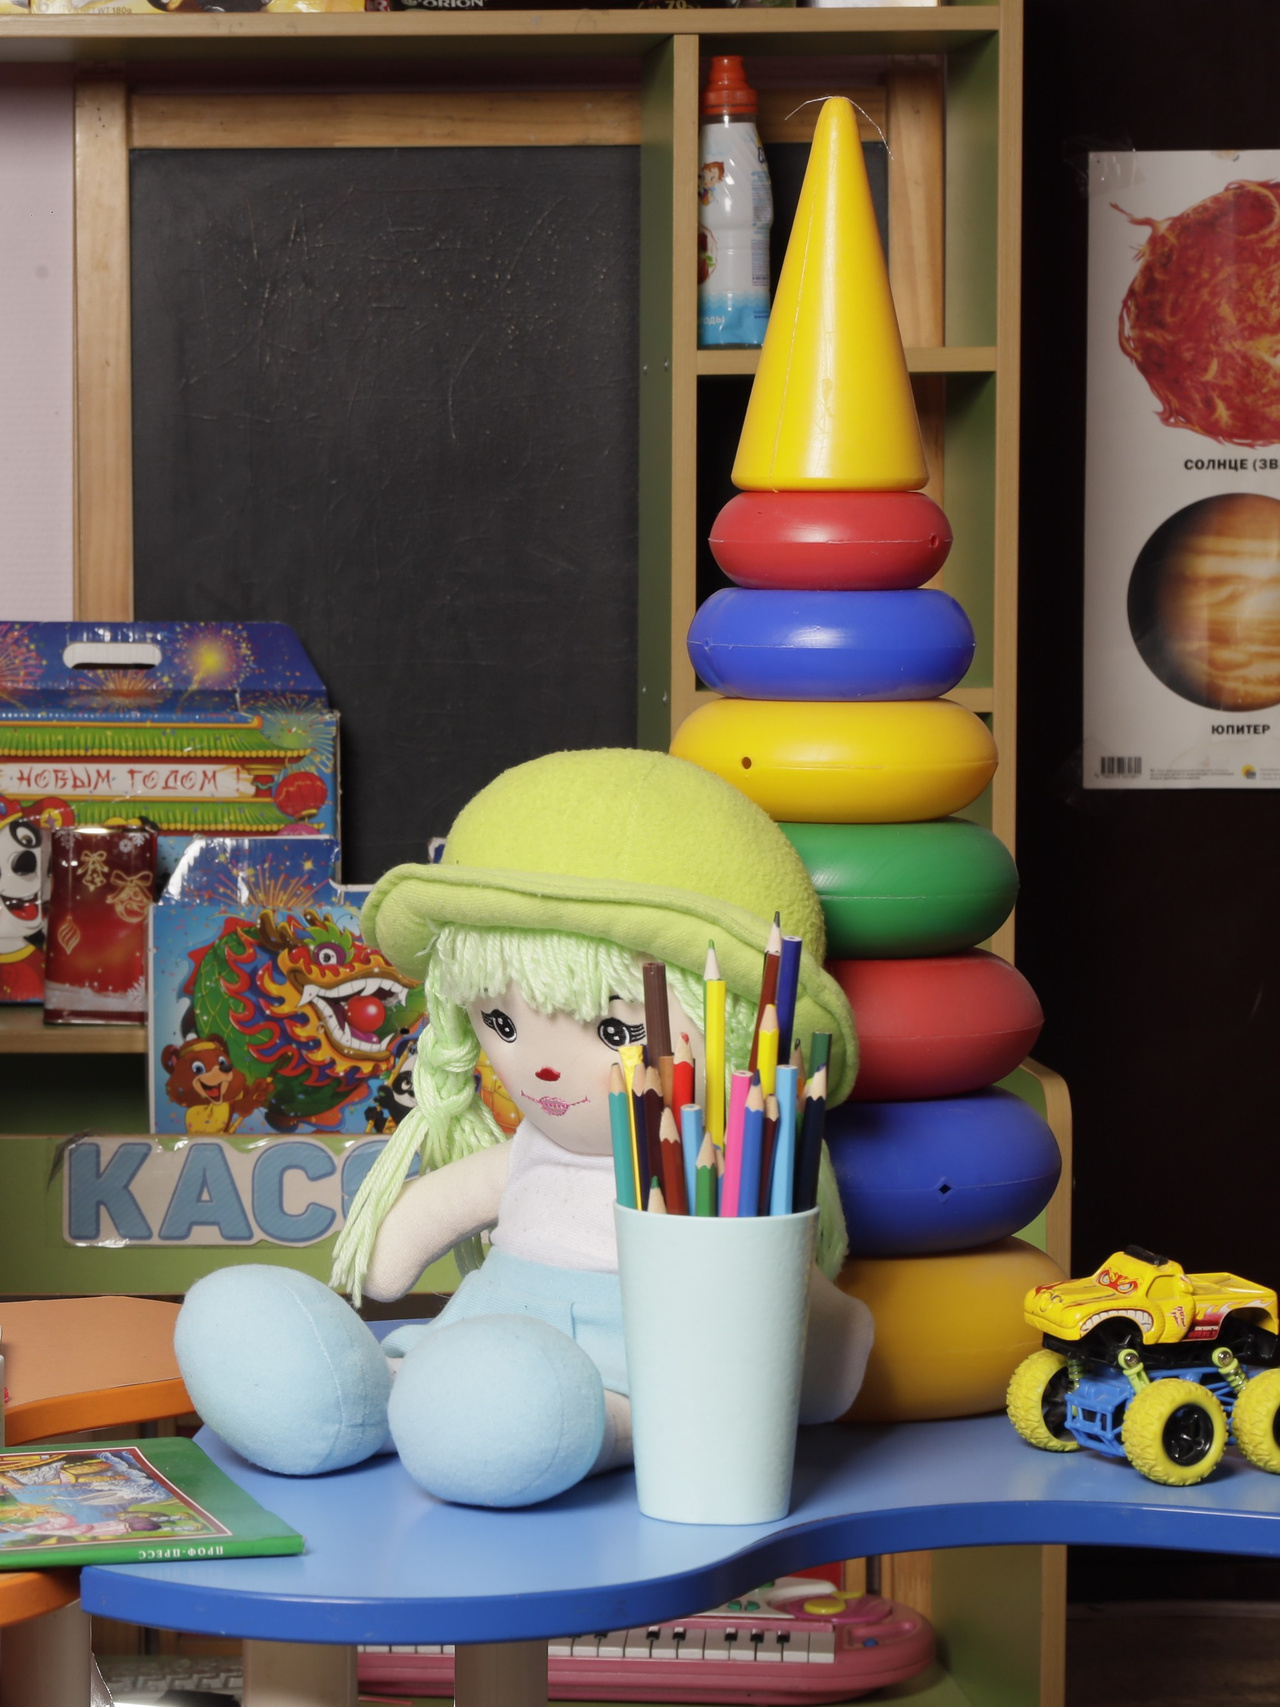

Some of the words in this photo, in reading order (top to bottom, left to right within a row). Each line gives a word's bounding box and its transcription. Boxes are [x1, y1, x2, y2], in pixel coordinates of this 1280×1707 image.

[1184, 459, 1248, 471] СОЛНЦЕ
[1253, 458, 1279, 472] (ЗВ
[1211, 724, 1270, 736] ЮПИТЕР
[17, 767, 113, 790] НОВЫМ
[139, 1546, 224, 1559] ПРОФ-ПРЕСС
